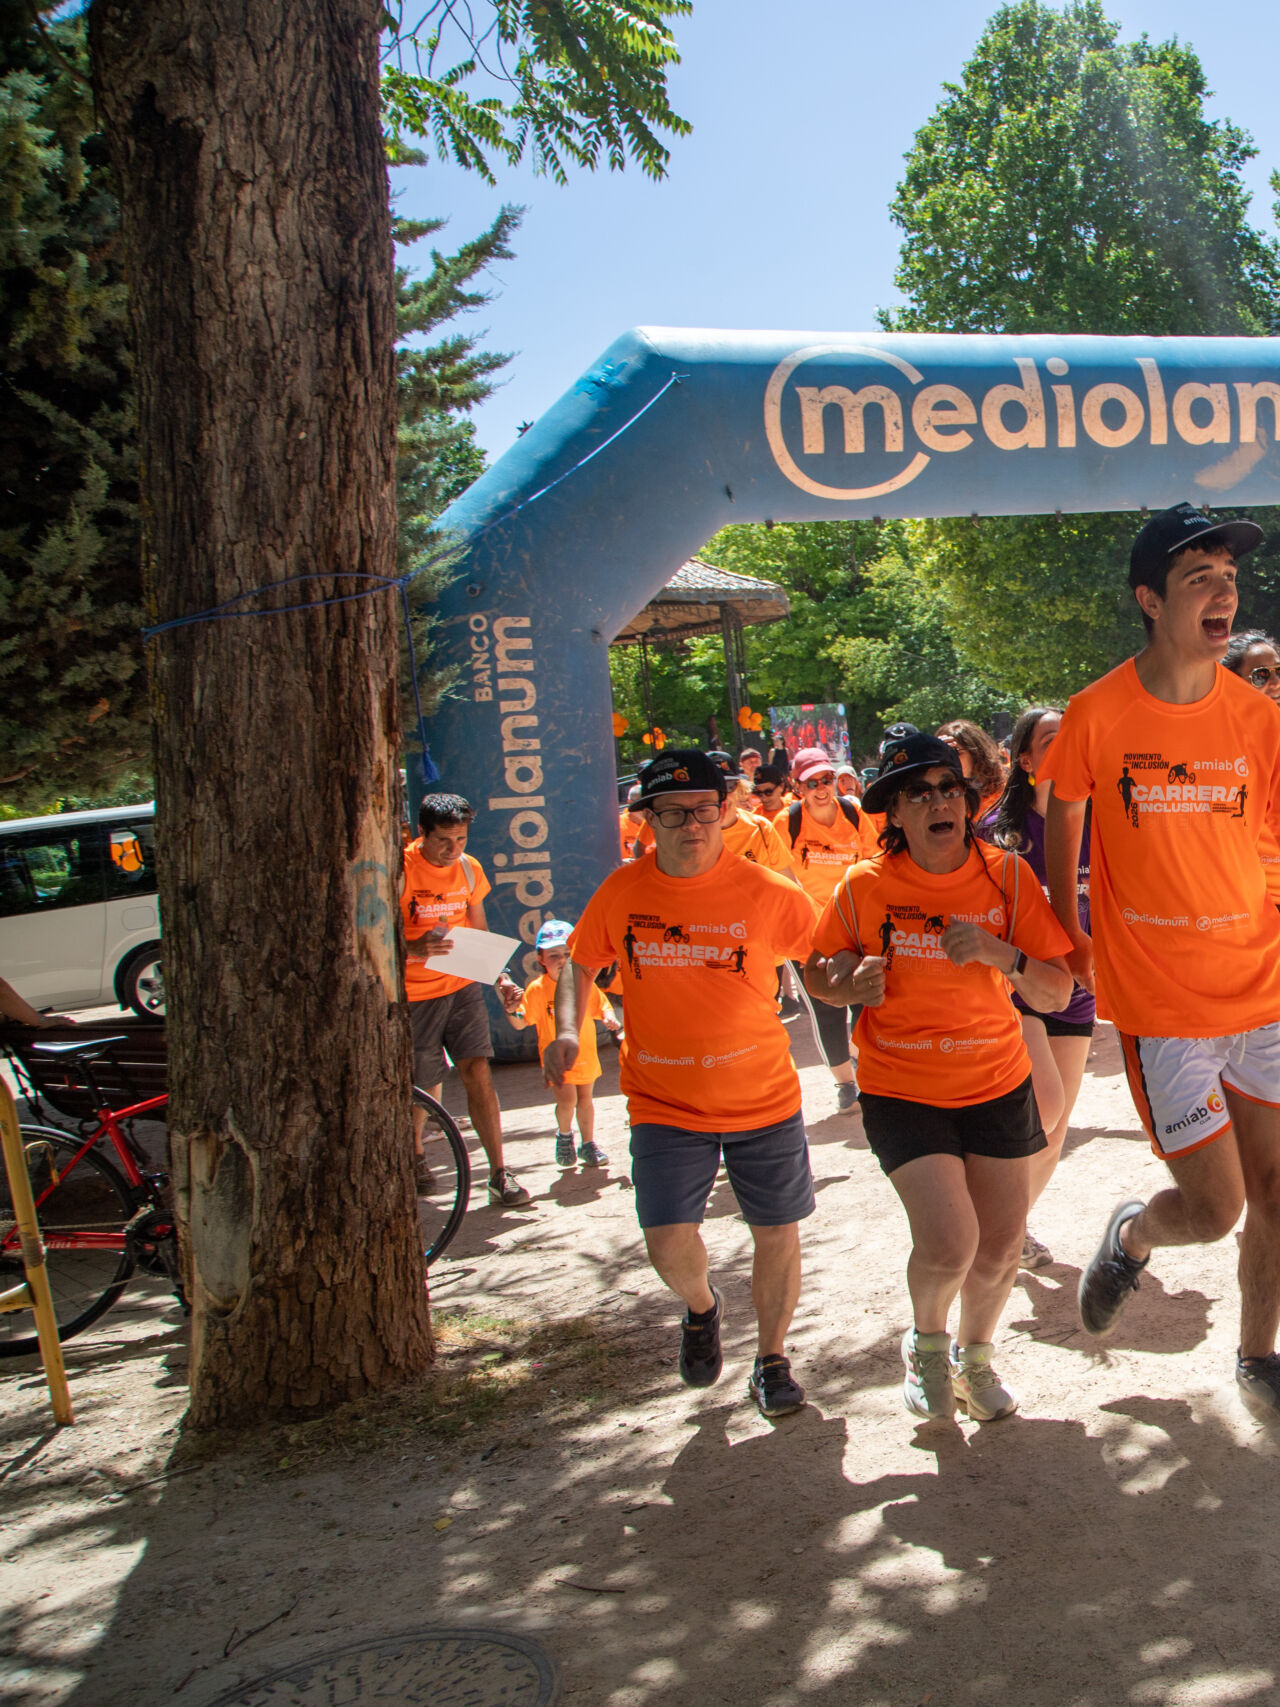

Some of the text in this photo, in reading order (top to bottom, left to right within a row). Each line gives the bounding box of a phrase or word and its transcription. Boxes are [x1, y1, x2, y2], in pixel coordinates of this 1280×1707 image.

[469, 613, 493, 703] BANCO
[1124, 753, 1161, 761] MOVIMIENTO
[1131, 761, 1169, 770] INCLUSIÓN
[1193, 759, 1233, 771] amiab
[1132, 785, 1241, 802] CARRERA
[1139, 802, 1210, 813] INCLUSIVA
[1131, 802, 1139, 828] 2026
[1123, 911, 1189, 927] mediolanum
[689, 923, 728, 934] amiab
[633, 941, 736, 961] CARRERA
[639, 957, 705, 967] INCLUSIVA
[640, 1053, 695, 1066] mediolanum
[1165, 1107, 1208, 1134] amiab
